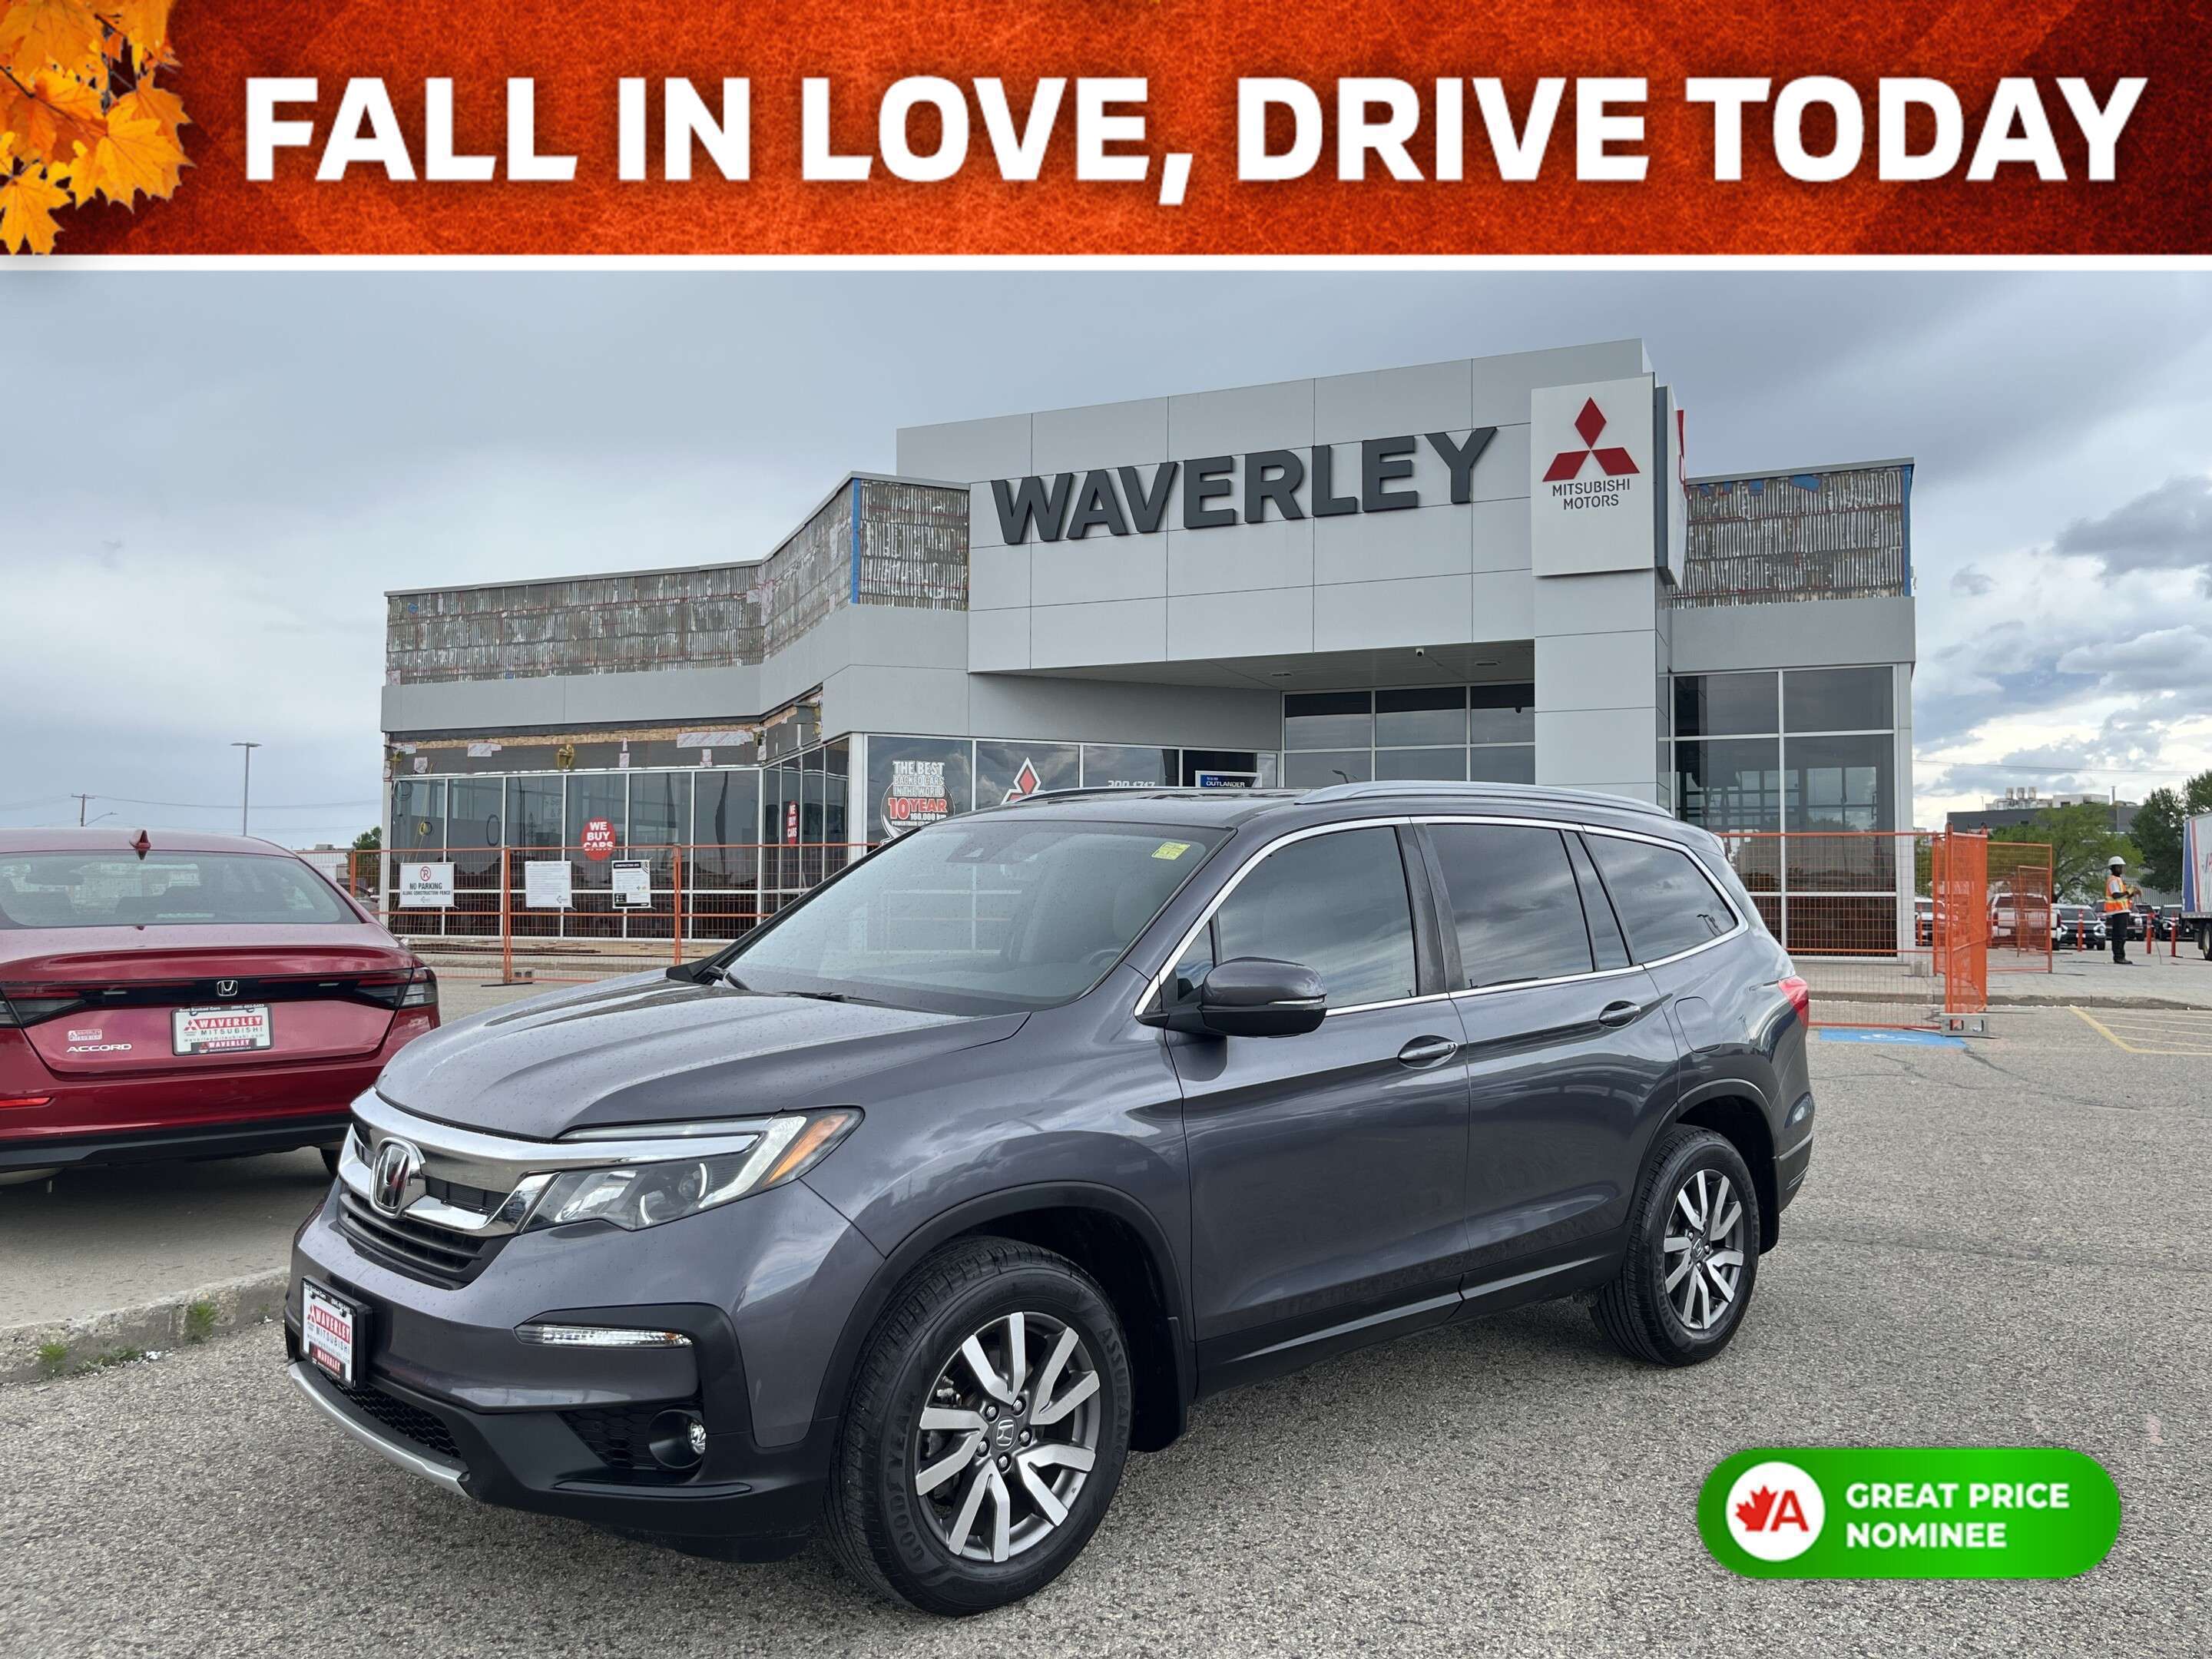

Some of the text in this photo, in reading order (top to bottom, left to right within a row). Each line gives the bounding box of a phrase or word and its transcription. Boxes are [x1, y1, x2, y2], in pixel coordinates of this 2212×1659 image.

[991, 426, 1497, 545] WAVERLEY
[1552, 478, 1630, 496] MITSUBISHI
[1564, 494, 1619, 510] MOTORS
[892, 760, 945, 775] THE BEST
[893, 775, 945, 785] BACKED CARS
[917, 787, 945, 796] WORLD
[889, 797, 948, 820] 10 YEAR
[590, 822, 608, 830] WE
[587, 832, 610, 840] BUY
[200, 1017, 261, 1028] WAVERLEY
[66, 1044, 132, 1052] ACCORD
[208, 1039, 250, 1048] WAVERLEY
[316, 1309, 350, 1344] WAVERLEY
[317, 1349, 340, 1372] WAVERLEY
